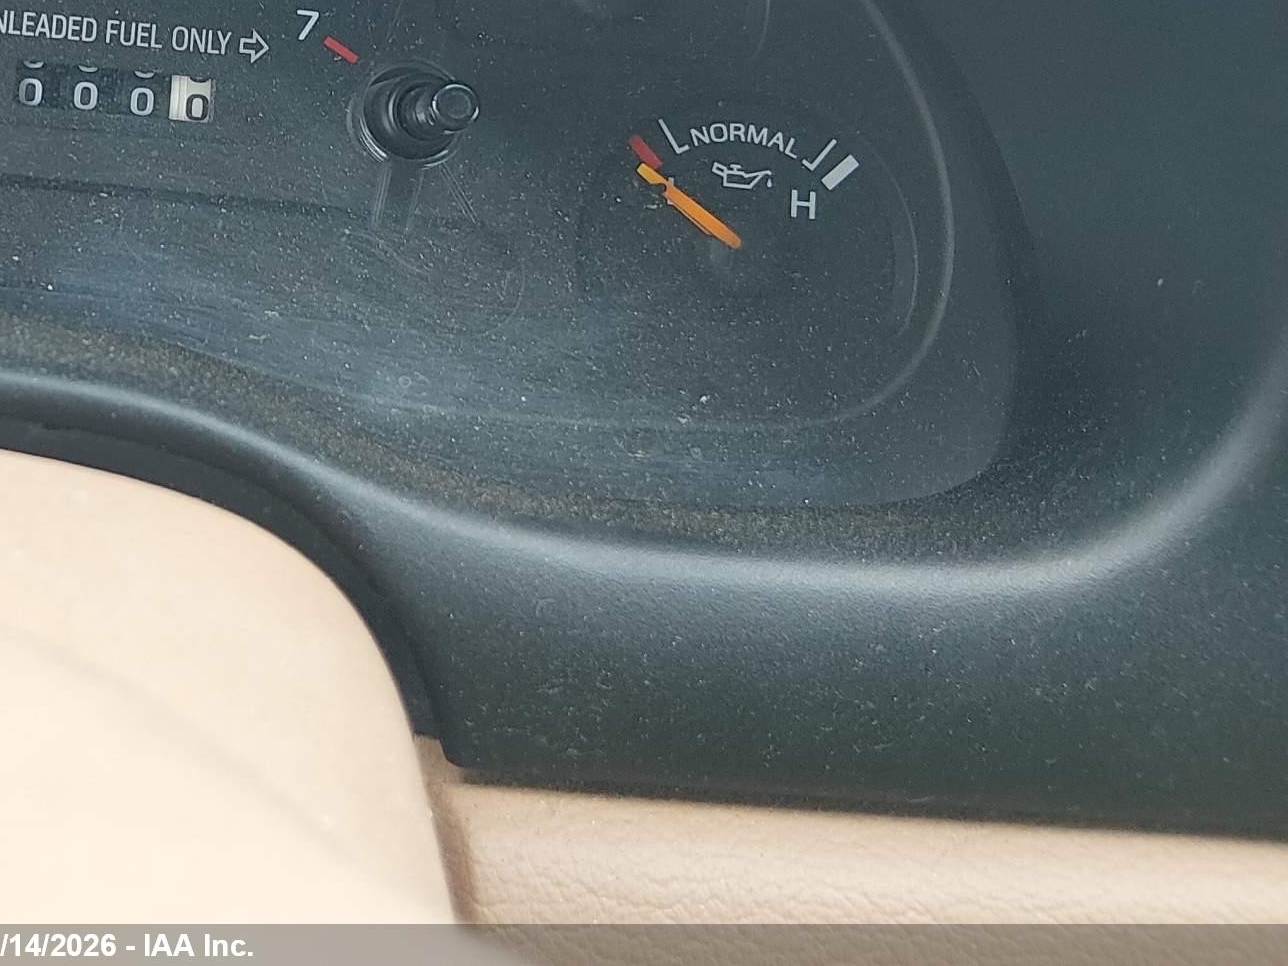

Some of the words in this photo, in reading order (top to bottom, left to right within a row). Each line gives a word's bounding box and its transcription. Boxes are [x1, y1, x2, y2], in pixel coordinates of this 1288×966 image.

[105, 20, 162, 49] FUEL
[172, 26, 232, 55] ONLY
[296, 9, 319, 41] 7
[690, 123, 797, 159] NORMAL
[791, 189, 816, 220] H
